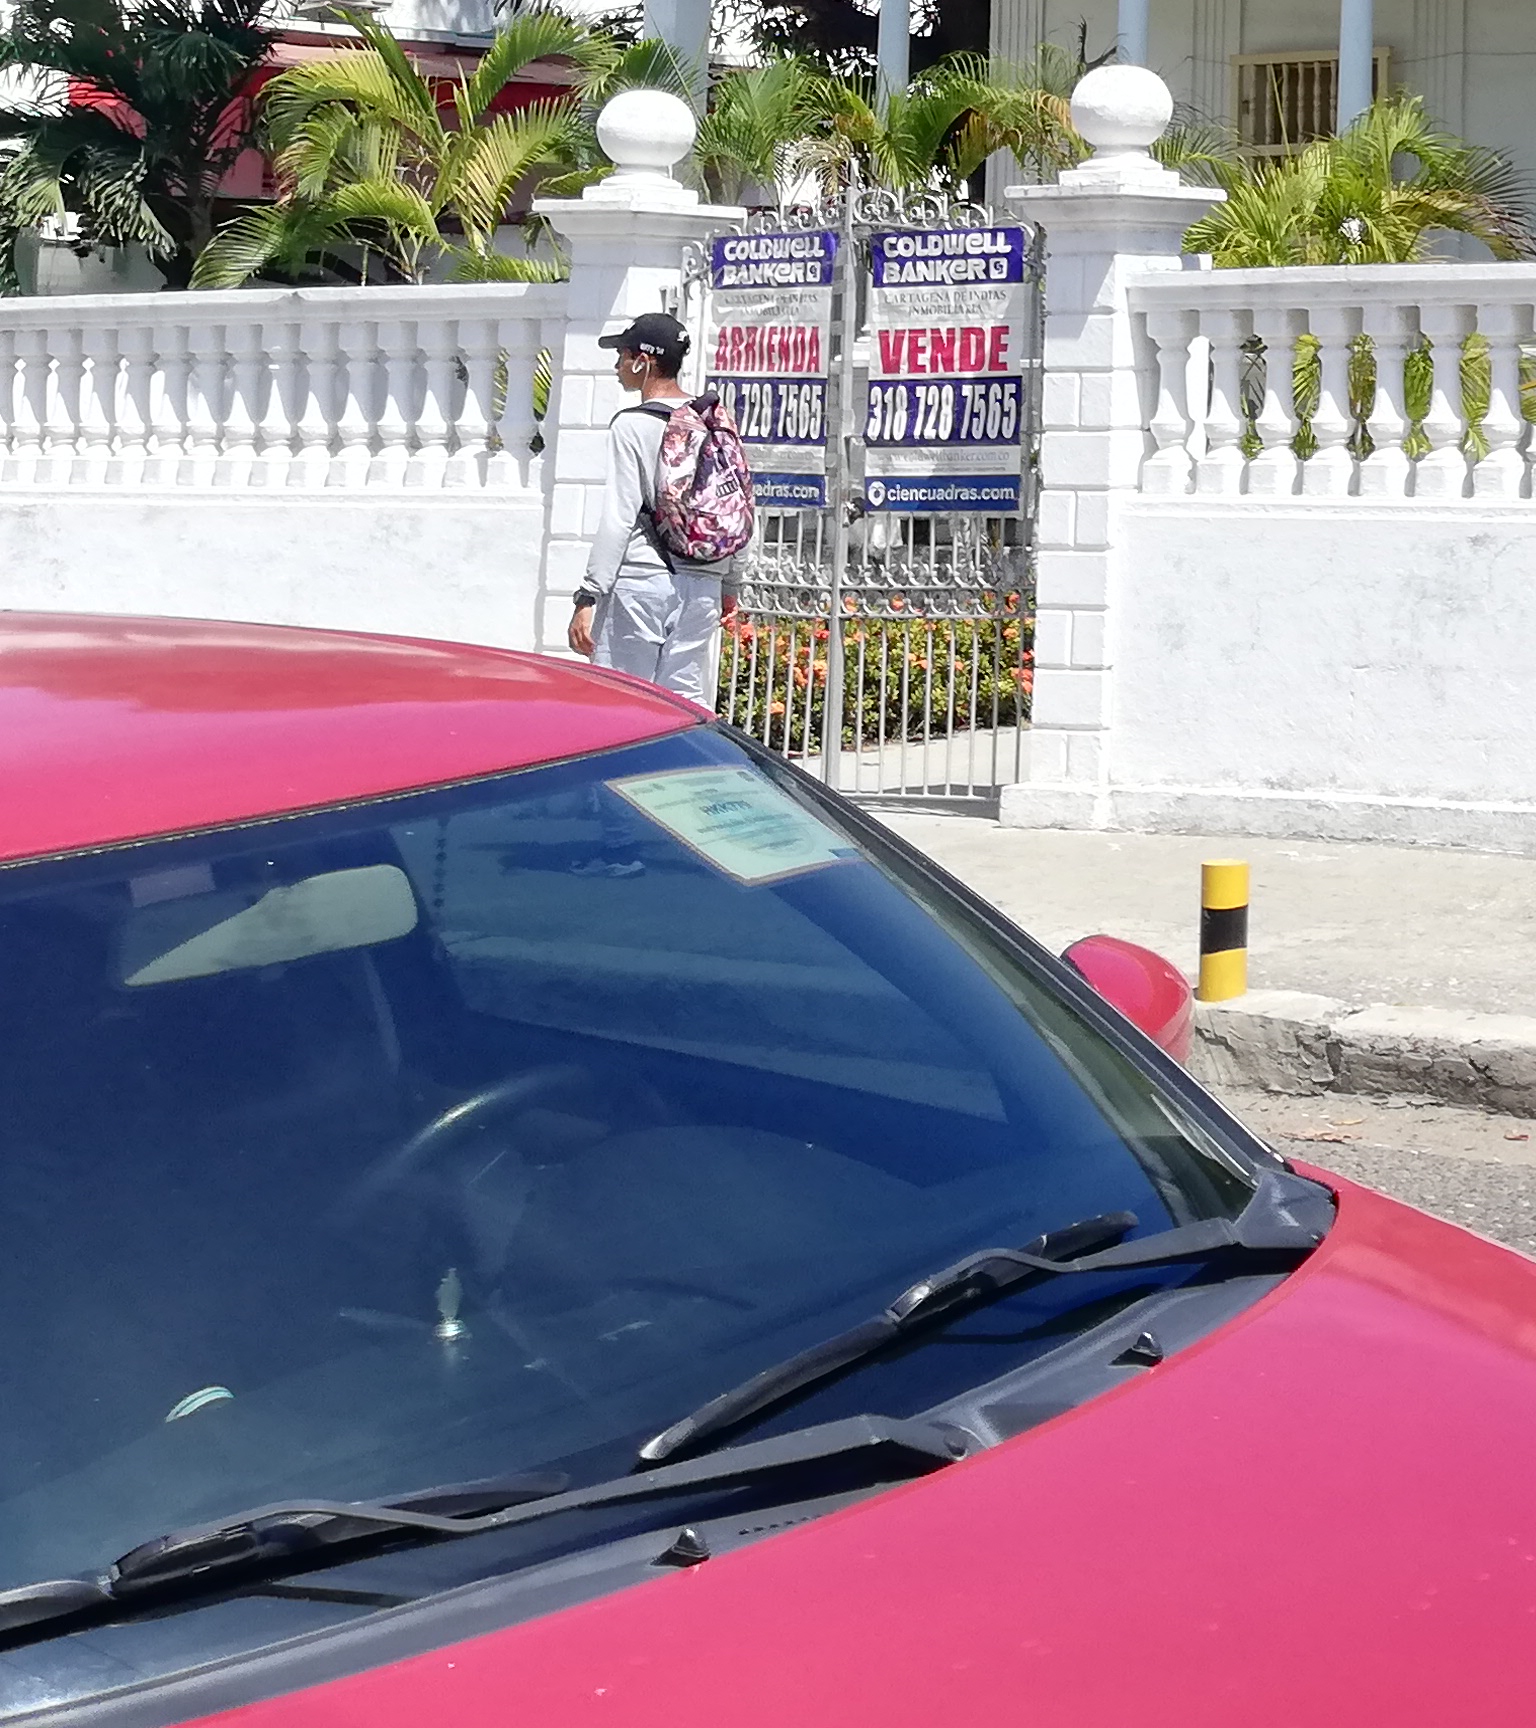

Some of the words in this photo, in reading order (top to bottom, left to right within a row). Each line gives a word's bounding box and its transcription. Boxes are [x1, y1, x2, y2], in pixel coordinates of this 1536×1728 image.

[884, 291, 950, 305] CARTAGENA
[954, 291, 966, 303] DE
[969, 289, 1007, 302] INDIAS
[715, 326, 820, 372] ARRIENDA
[878, 325, 1010, 374] VENDE
[740, 383, 772, 437] 728
[777, 384, 822, 440] 7565
[867, 385, 908, 441] 318
[914, 385, 954, 440] 728
[960, 383, 1017, 440] 7565
[887, 484, 1015, 502] ciencuadras.com
